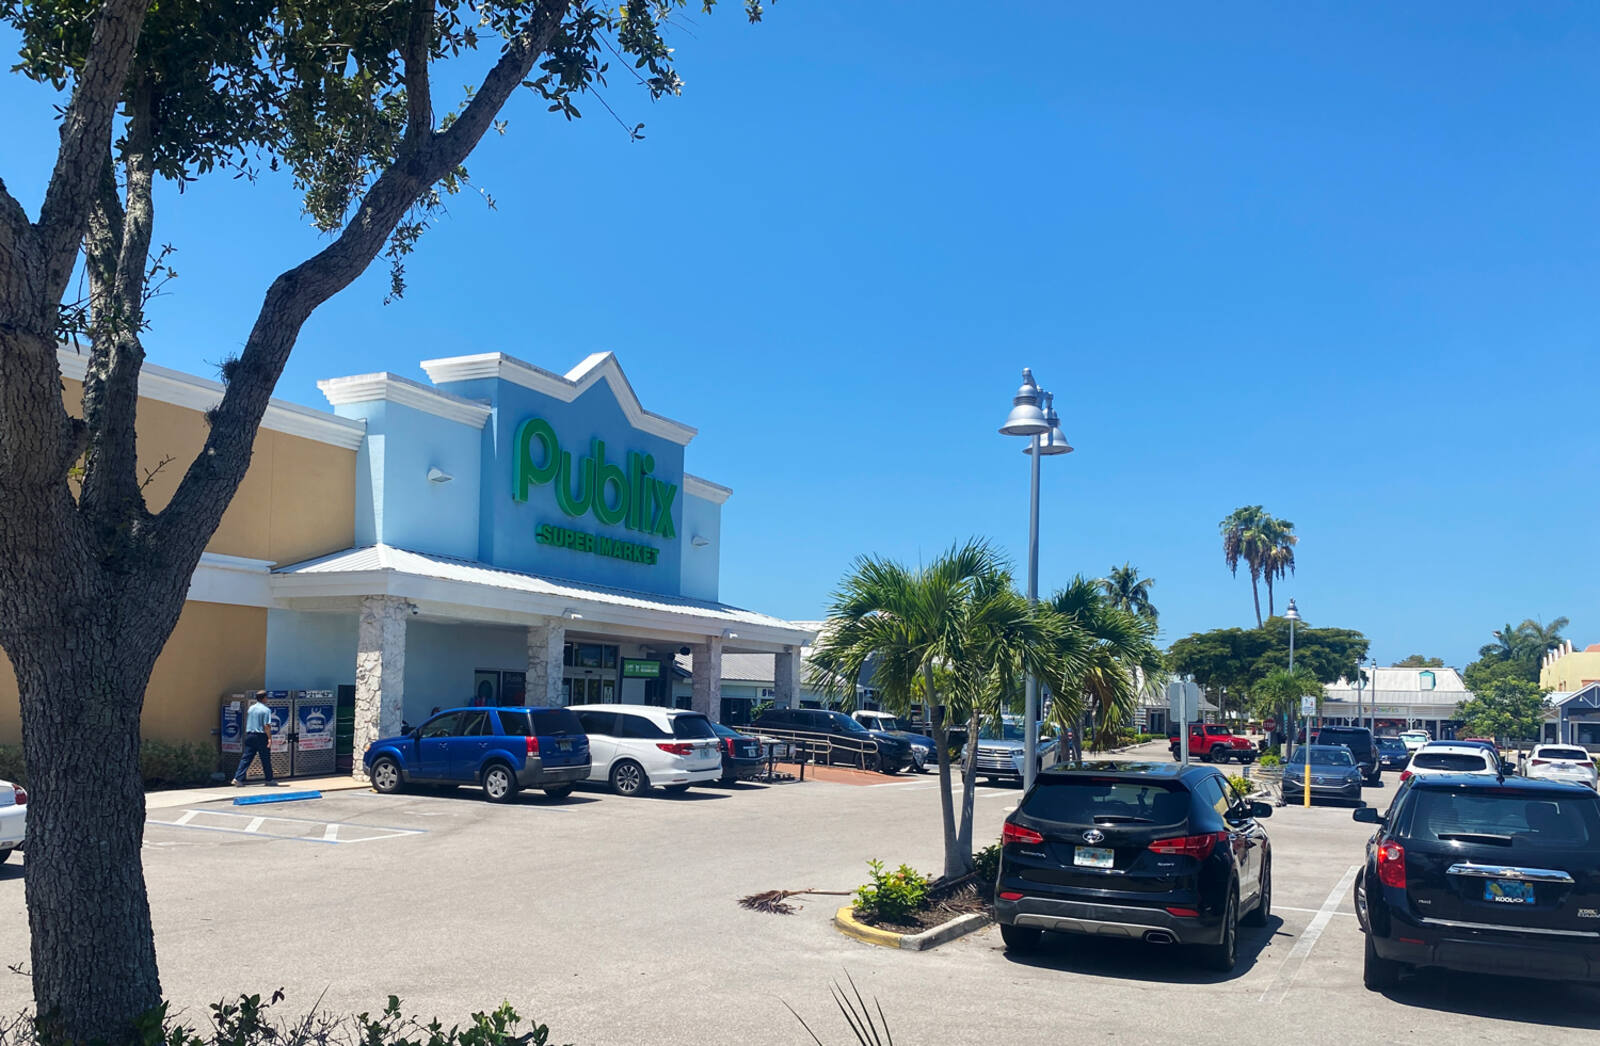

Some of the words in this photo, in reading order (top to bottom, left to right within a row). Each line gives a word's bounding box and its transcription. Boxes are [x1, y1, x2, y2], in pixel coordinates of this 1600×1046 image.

[512, 417, 678, 539] Publix
[536, 523, 595, 553] SUPER
[598, 536, 660, 565] MARKET
